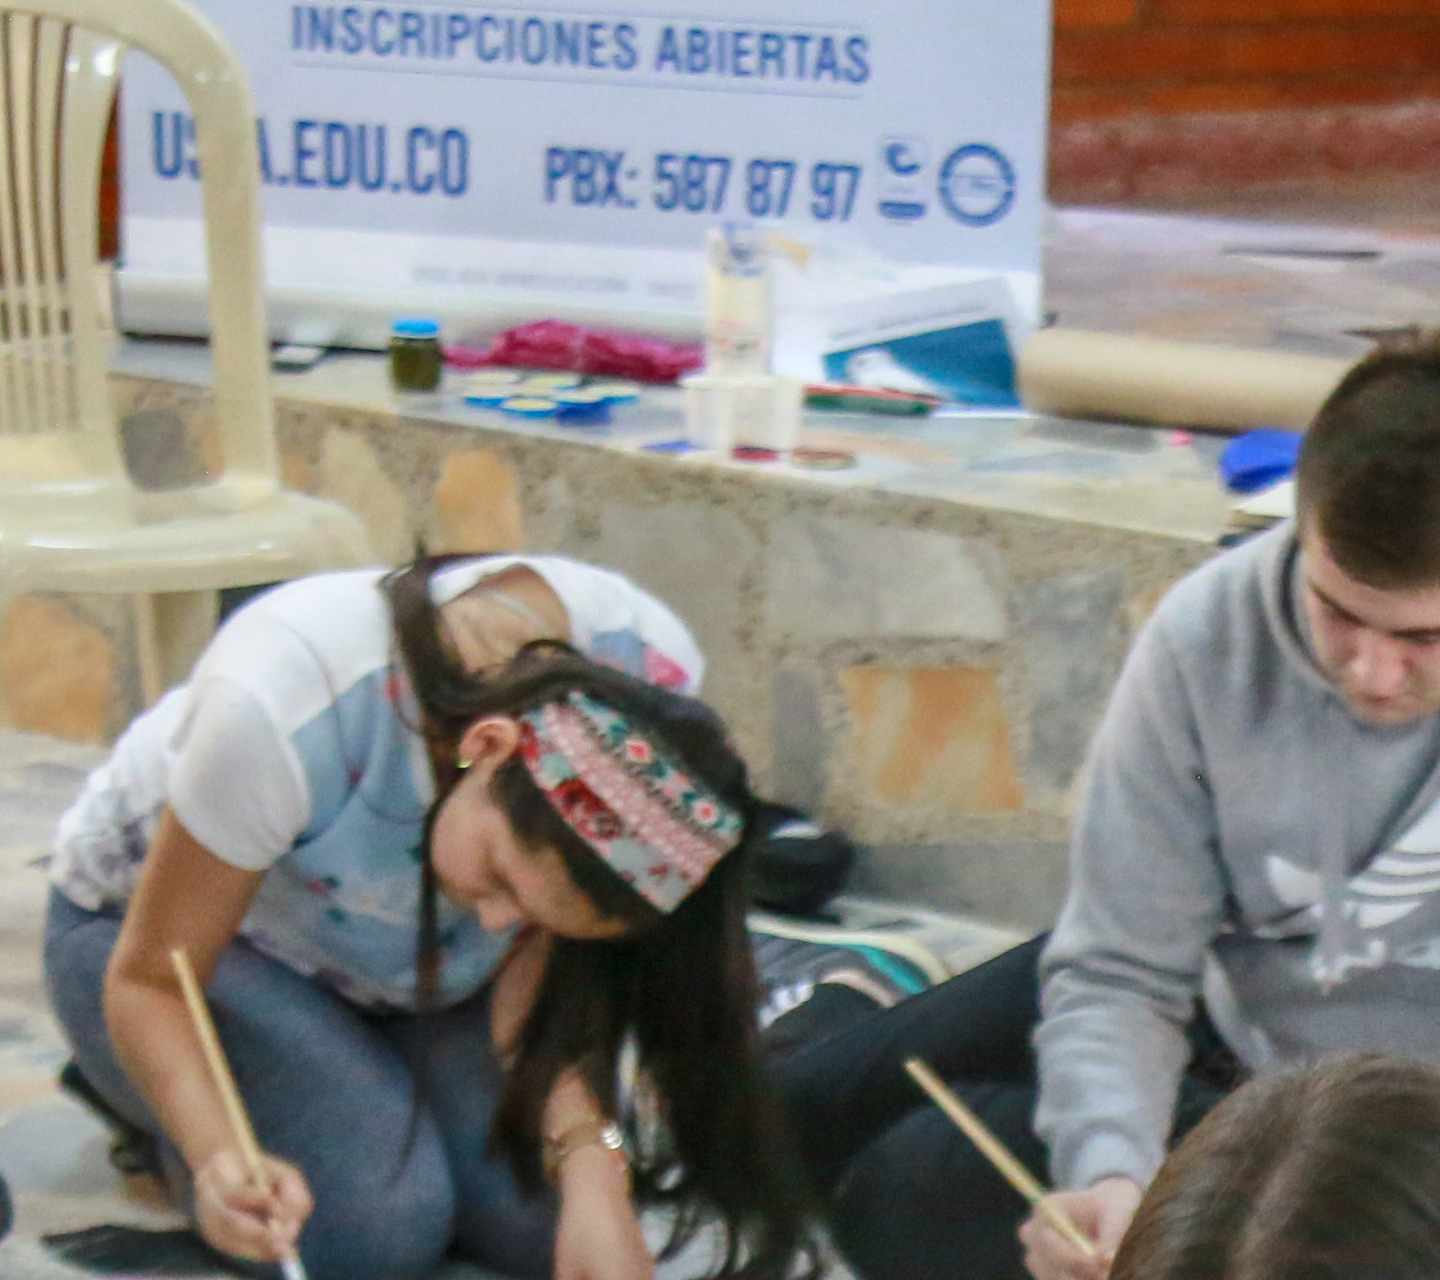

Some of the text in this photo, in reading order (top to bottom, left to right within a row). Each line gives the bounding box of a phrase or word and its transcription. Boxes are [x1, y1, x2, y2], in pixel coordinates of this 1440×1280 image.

[291, 5, 871, 85] INSCRIPCIONES ABIERTAS
[546, 146, 637, 208] PBX:
[656, 153, 732, 213] 587
[746, 158, 797, 218] 87
[810, 163, 864, 222] 97
